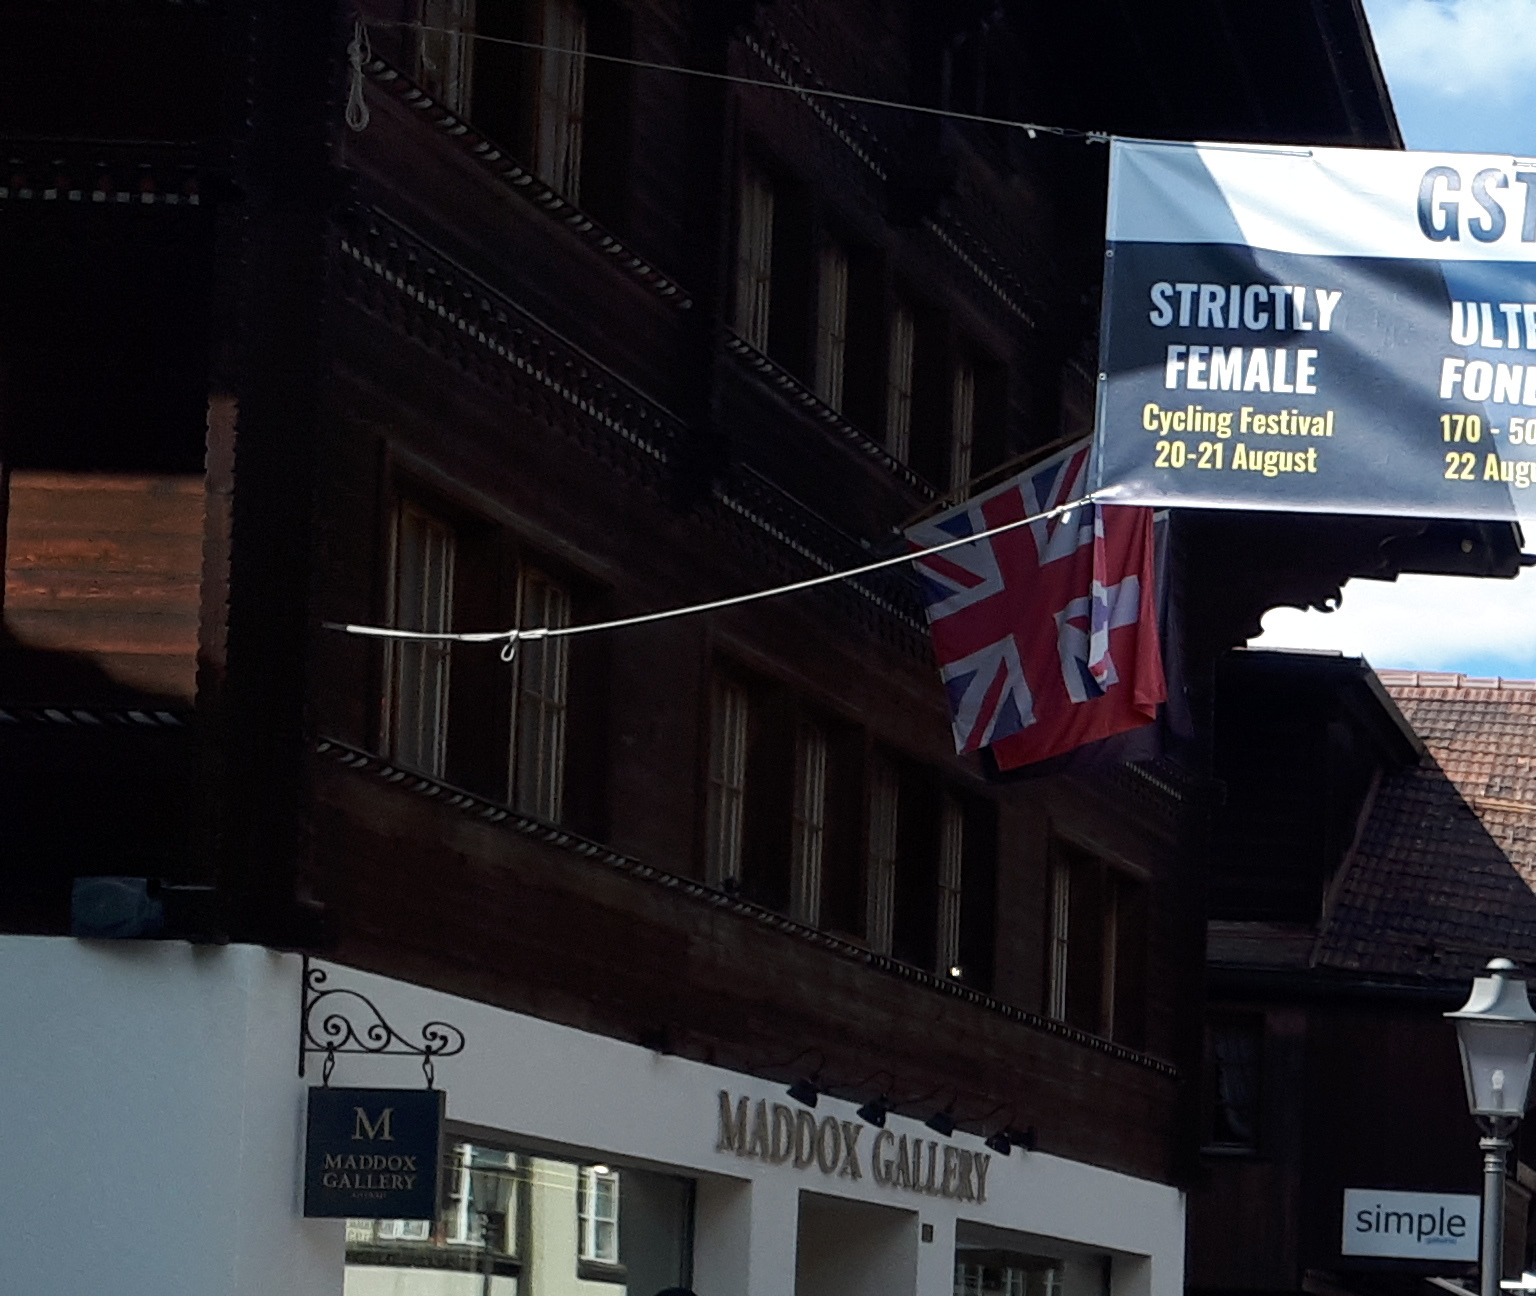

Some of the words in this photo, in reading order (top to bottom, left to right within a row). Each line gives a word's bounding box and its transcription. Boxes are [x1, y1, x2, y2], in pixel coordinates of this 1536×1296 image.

[1149, 281, 1343, 332] STRICTLY
[1164, 345, 1318, 395] FEMALE
[1142, 403, 1232, 437] Cycling
[1239, 406, 1334, 437] Festival
[1439, 413, 1482, 443] 170
[1154, 441, 1224, 470] 20-21
[1231, 444, 1317, 477] August
[1445, 452, 1475, 481] 22
[351, 1106, 395, 1141] M
[324, 1153, 417, 1172] MADDOX
[716, 1089, 863, 1181] MADDOX
[871, 1128, 991, 1204] GALLERY
[322, 1172, 417, 1191] GALLERY
[1355, 1203, 1466, 1243] simple
